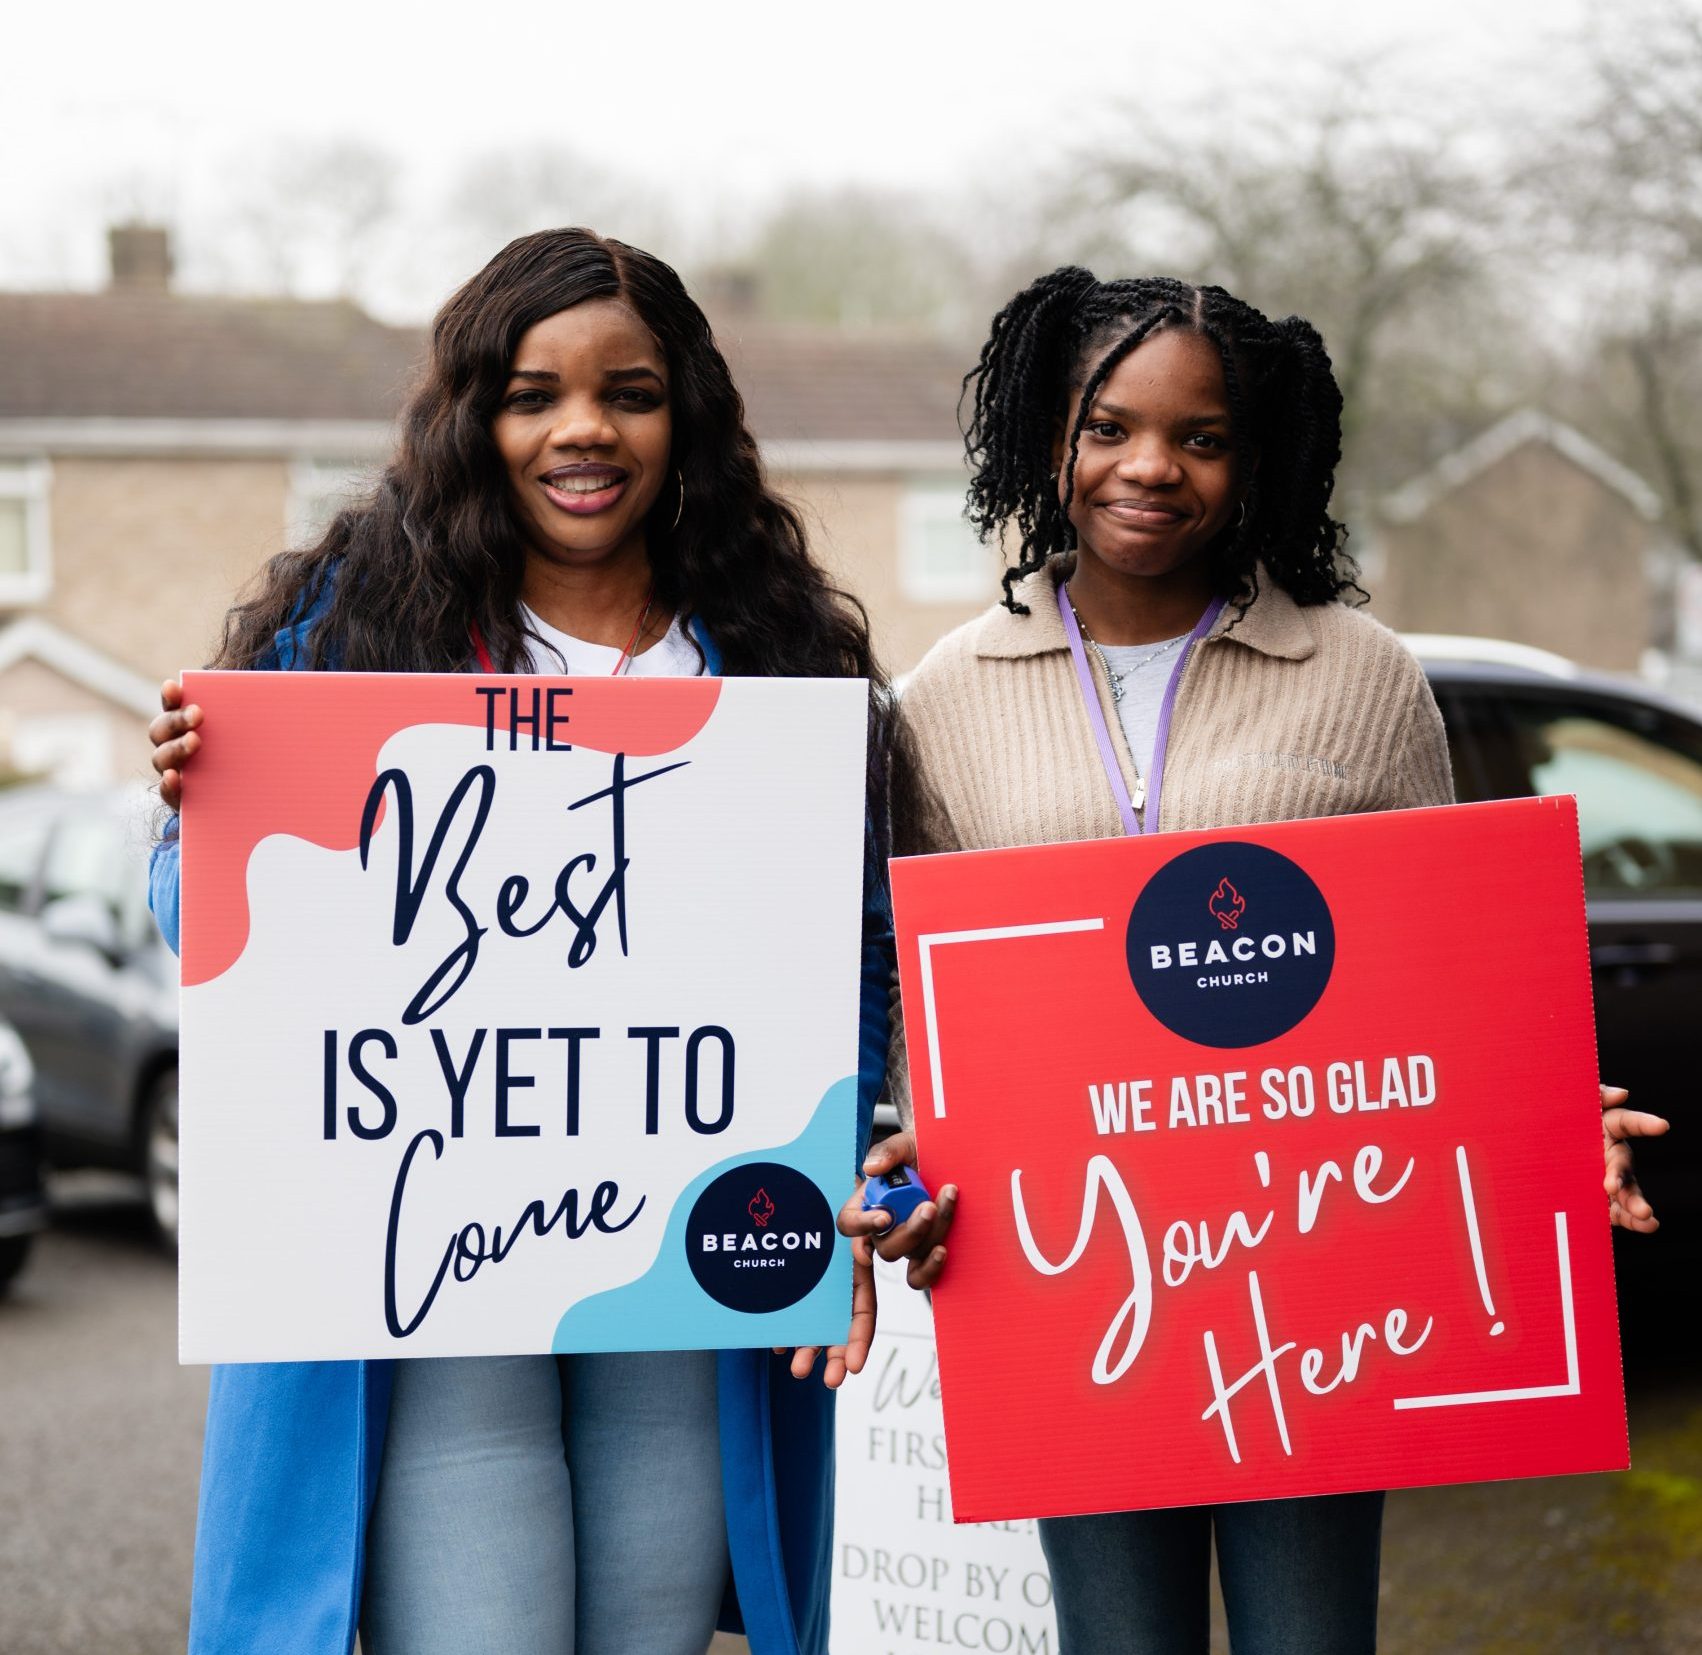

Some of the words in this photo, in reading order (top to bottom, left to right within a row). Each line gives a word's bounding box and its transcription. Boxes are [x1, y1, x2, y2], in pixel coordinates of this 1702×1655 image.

[476, 687, 574, 752] THE
[358, 752, 692, 1026] Best
[1150, 930, 1317, 970] BEACON
[1196, 971, 1269, 989] CHURCH
[323, 1028, 398, 1141] IS
[430, 1027, 601, 1139] YET
[627, 1025, 736, 1136] TO
[1088, 1079, 1157, 1135] WE
[1168, 1071, 1251, 1129] ARE
[1261, 1065, 1316, 1120] SO
[1326, 1054, 1437, 1114] GLAD
[384, 1128, 647, 1339] Come
[702, 1231, 822, 1252] BEACON
[733, 1258, 786, 1268] CHURCH
[1010, 1145, 1416, 1385] You're
[841, 1543, 949, 1592] DROP
[965, 1562, 1009, 1602] BY
